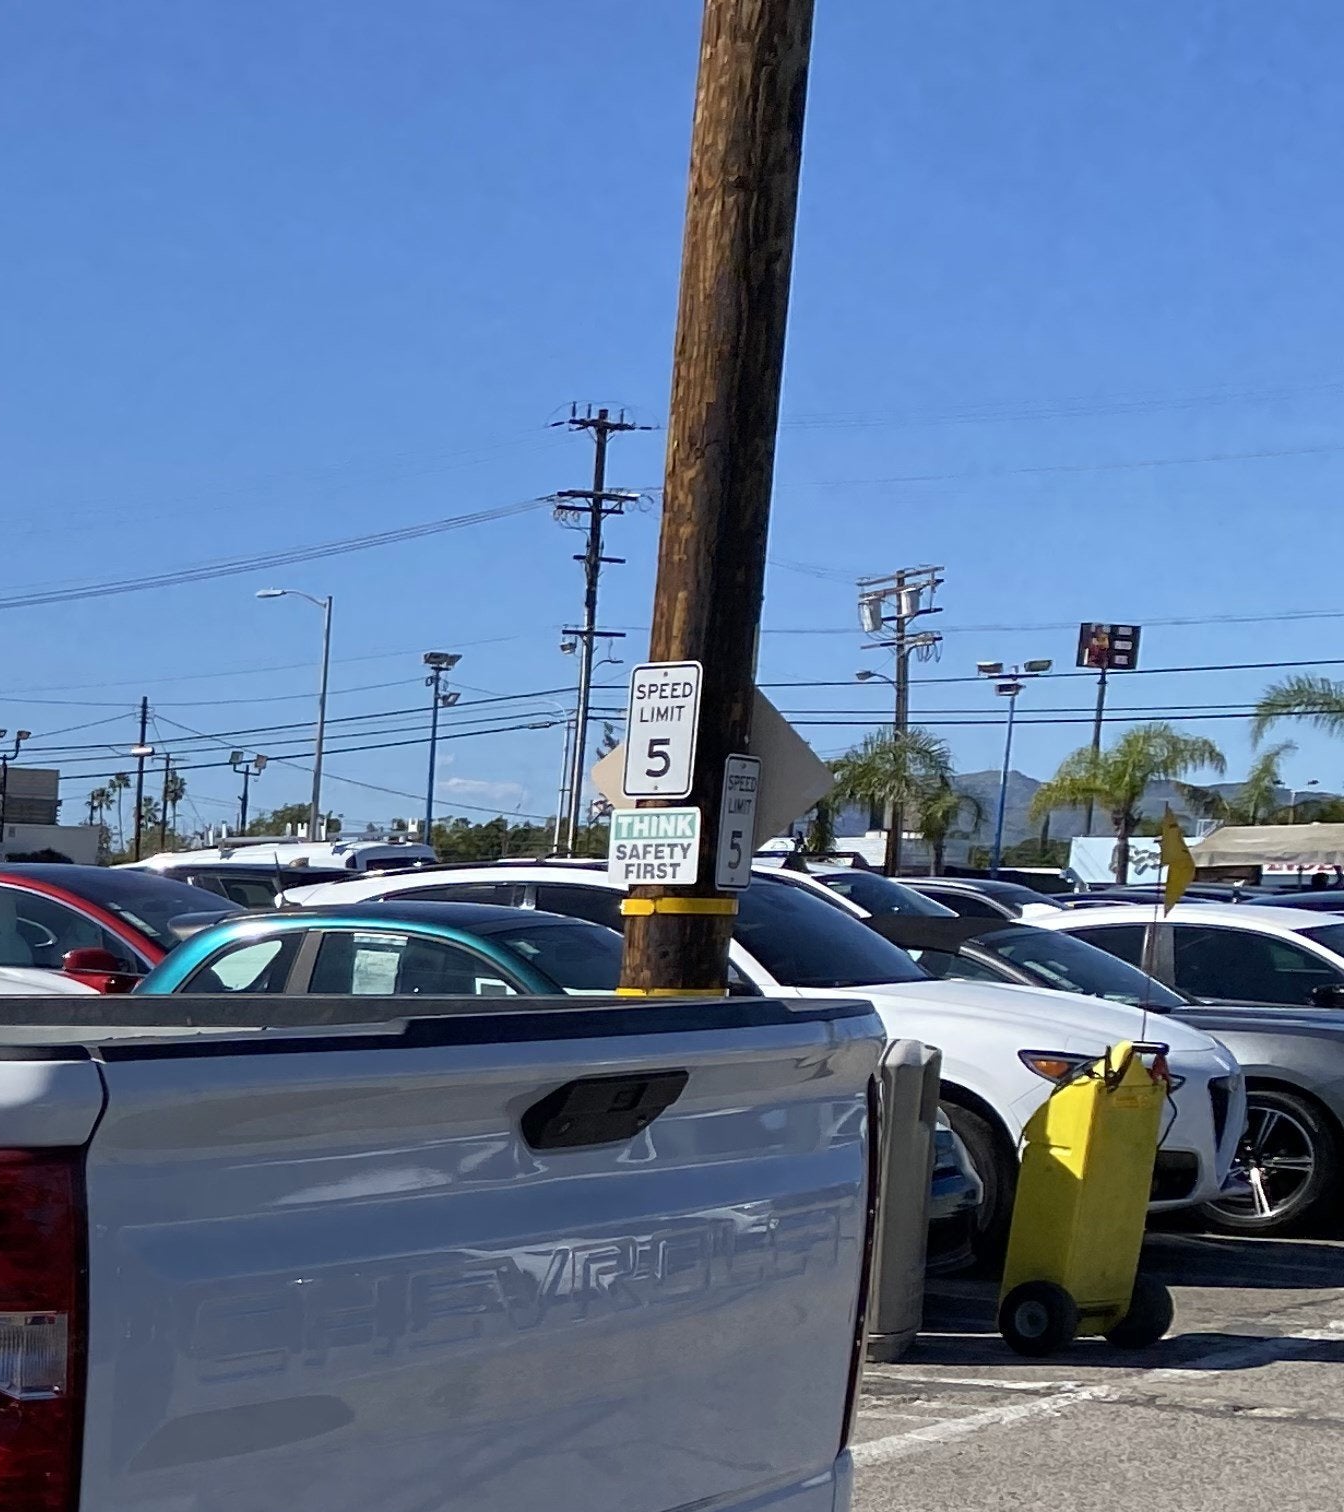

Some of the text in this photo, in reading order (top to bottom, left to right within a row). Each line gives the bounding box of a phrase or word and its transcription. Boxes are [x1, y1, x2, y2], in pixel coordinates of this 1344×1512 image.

[635, 682, 693, 700] SPEED
[639, 705, 686, 723] LIMIT
[645, 738, 671, 777] 5
[728, 774, 757, 792] SPEED
[728, 798, 752, 815] LIMIT
[618, 814, 694, 839] THINK
[616, 842, 692, 861] SAFETY
[728, 830, 743, 869] 5
[624, 863, 681, 880] FIRST
